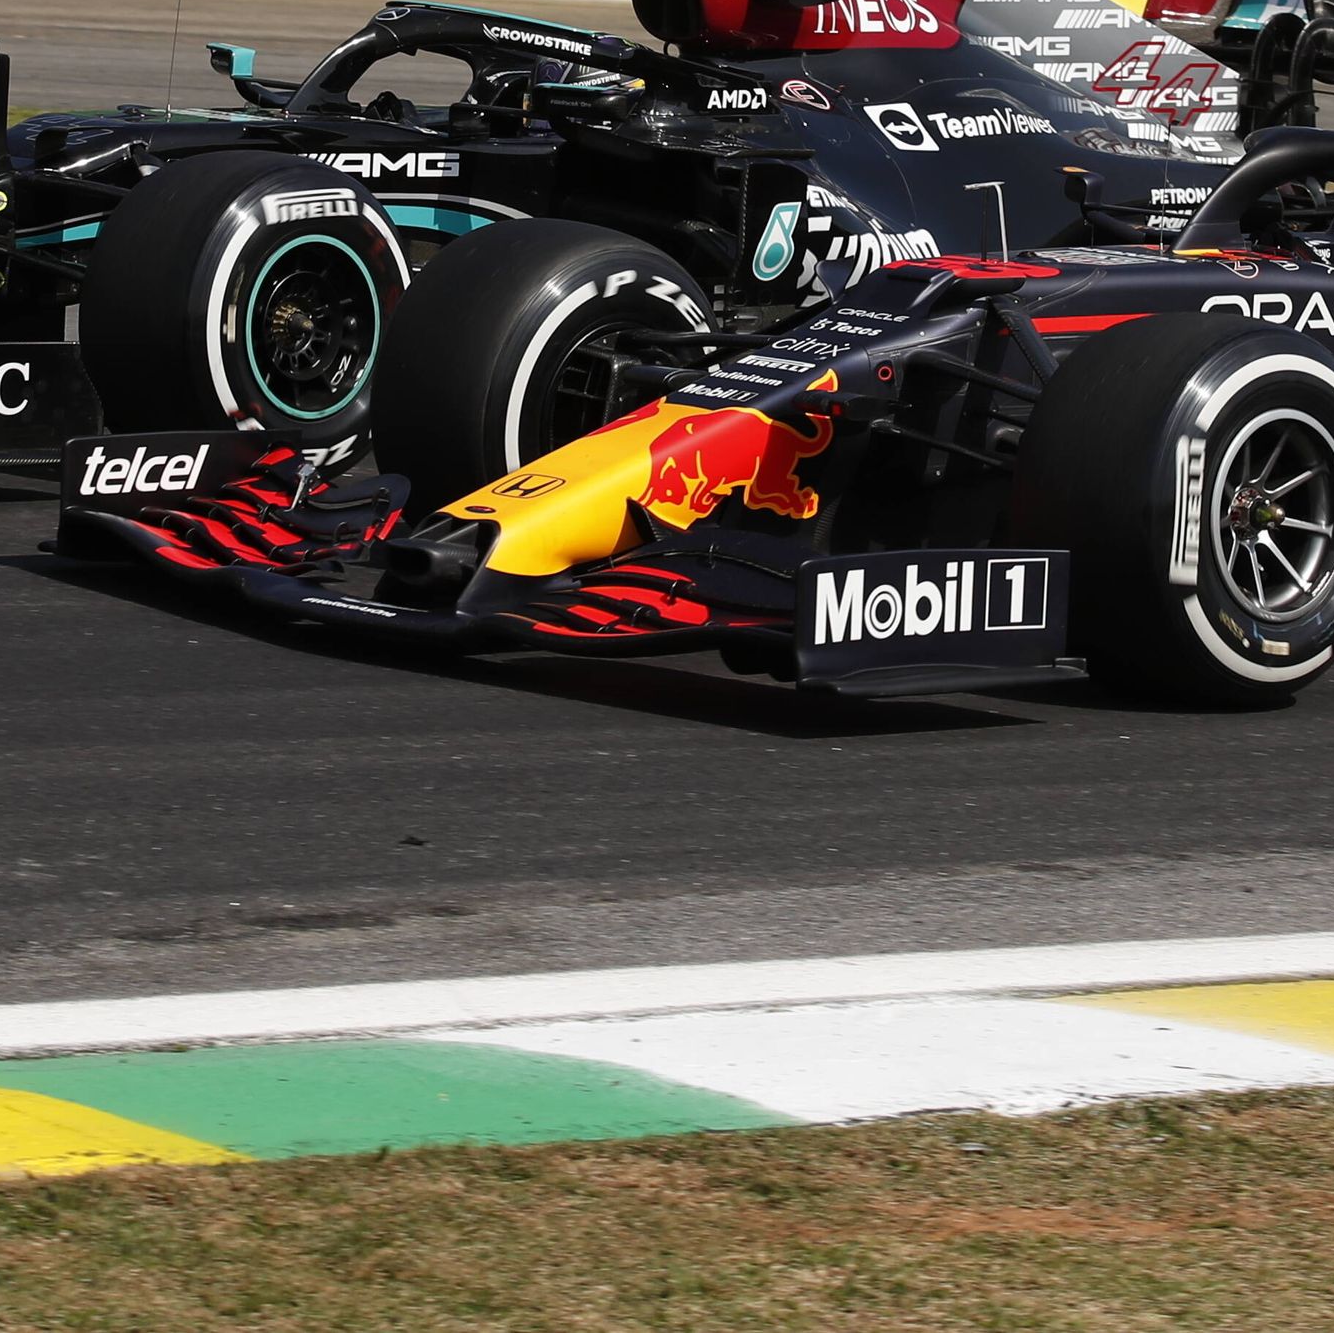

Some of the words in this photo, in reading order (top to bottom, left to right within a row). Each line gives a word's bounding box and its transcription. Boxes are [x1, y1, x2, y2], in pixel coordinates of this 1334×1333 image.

[489, 25, 592, 56] CROWDSTRIKE
[995, 36, 1071, 56] AMG
[569, 72, 622, 87] ROWDSTRIKE
[1092, 41, 1220, 126] 44
[707, 89, 754, 110] AMD
[927, 107, 1058, 139] TeamViewer
[334, 153, 460, 178] AMG
[262, 188, 359, 225] PIRELLI
[1151, 187, 1213, 206] PETRON
[603, 269, 638, 299] P
[837, 307, 909, 323] ORACLE
[831, 321, 883, 336] Tezos
[772, 337, 851, 357] citrix
[737, 354, 816, 373] PIRELLI
[711, 368, 783, 386] infinitum
[678, 383, 733, 400] Mobil
[79, 443, 210, 496] telcel
[1169, 434, 1207, 586] PIRELLI
[813, 560, 975, 646] Mobil
